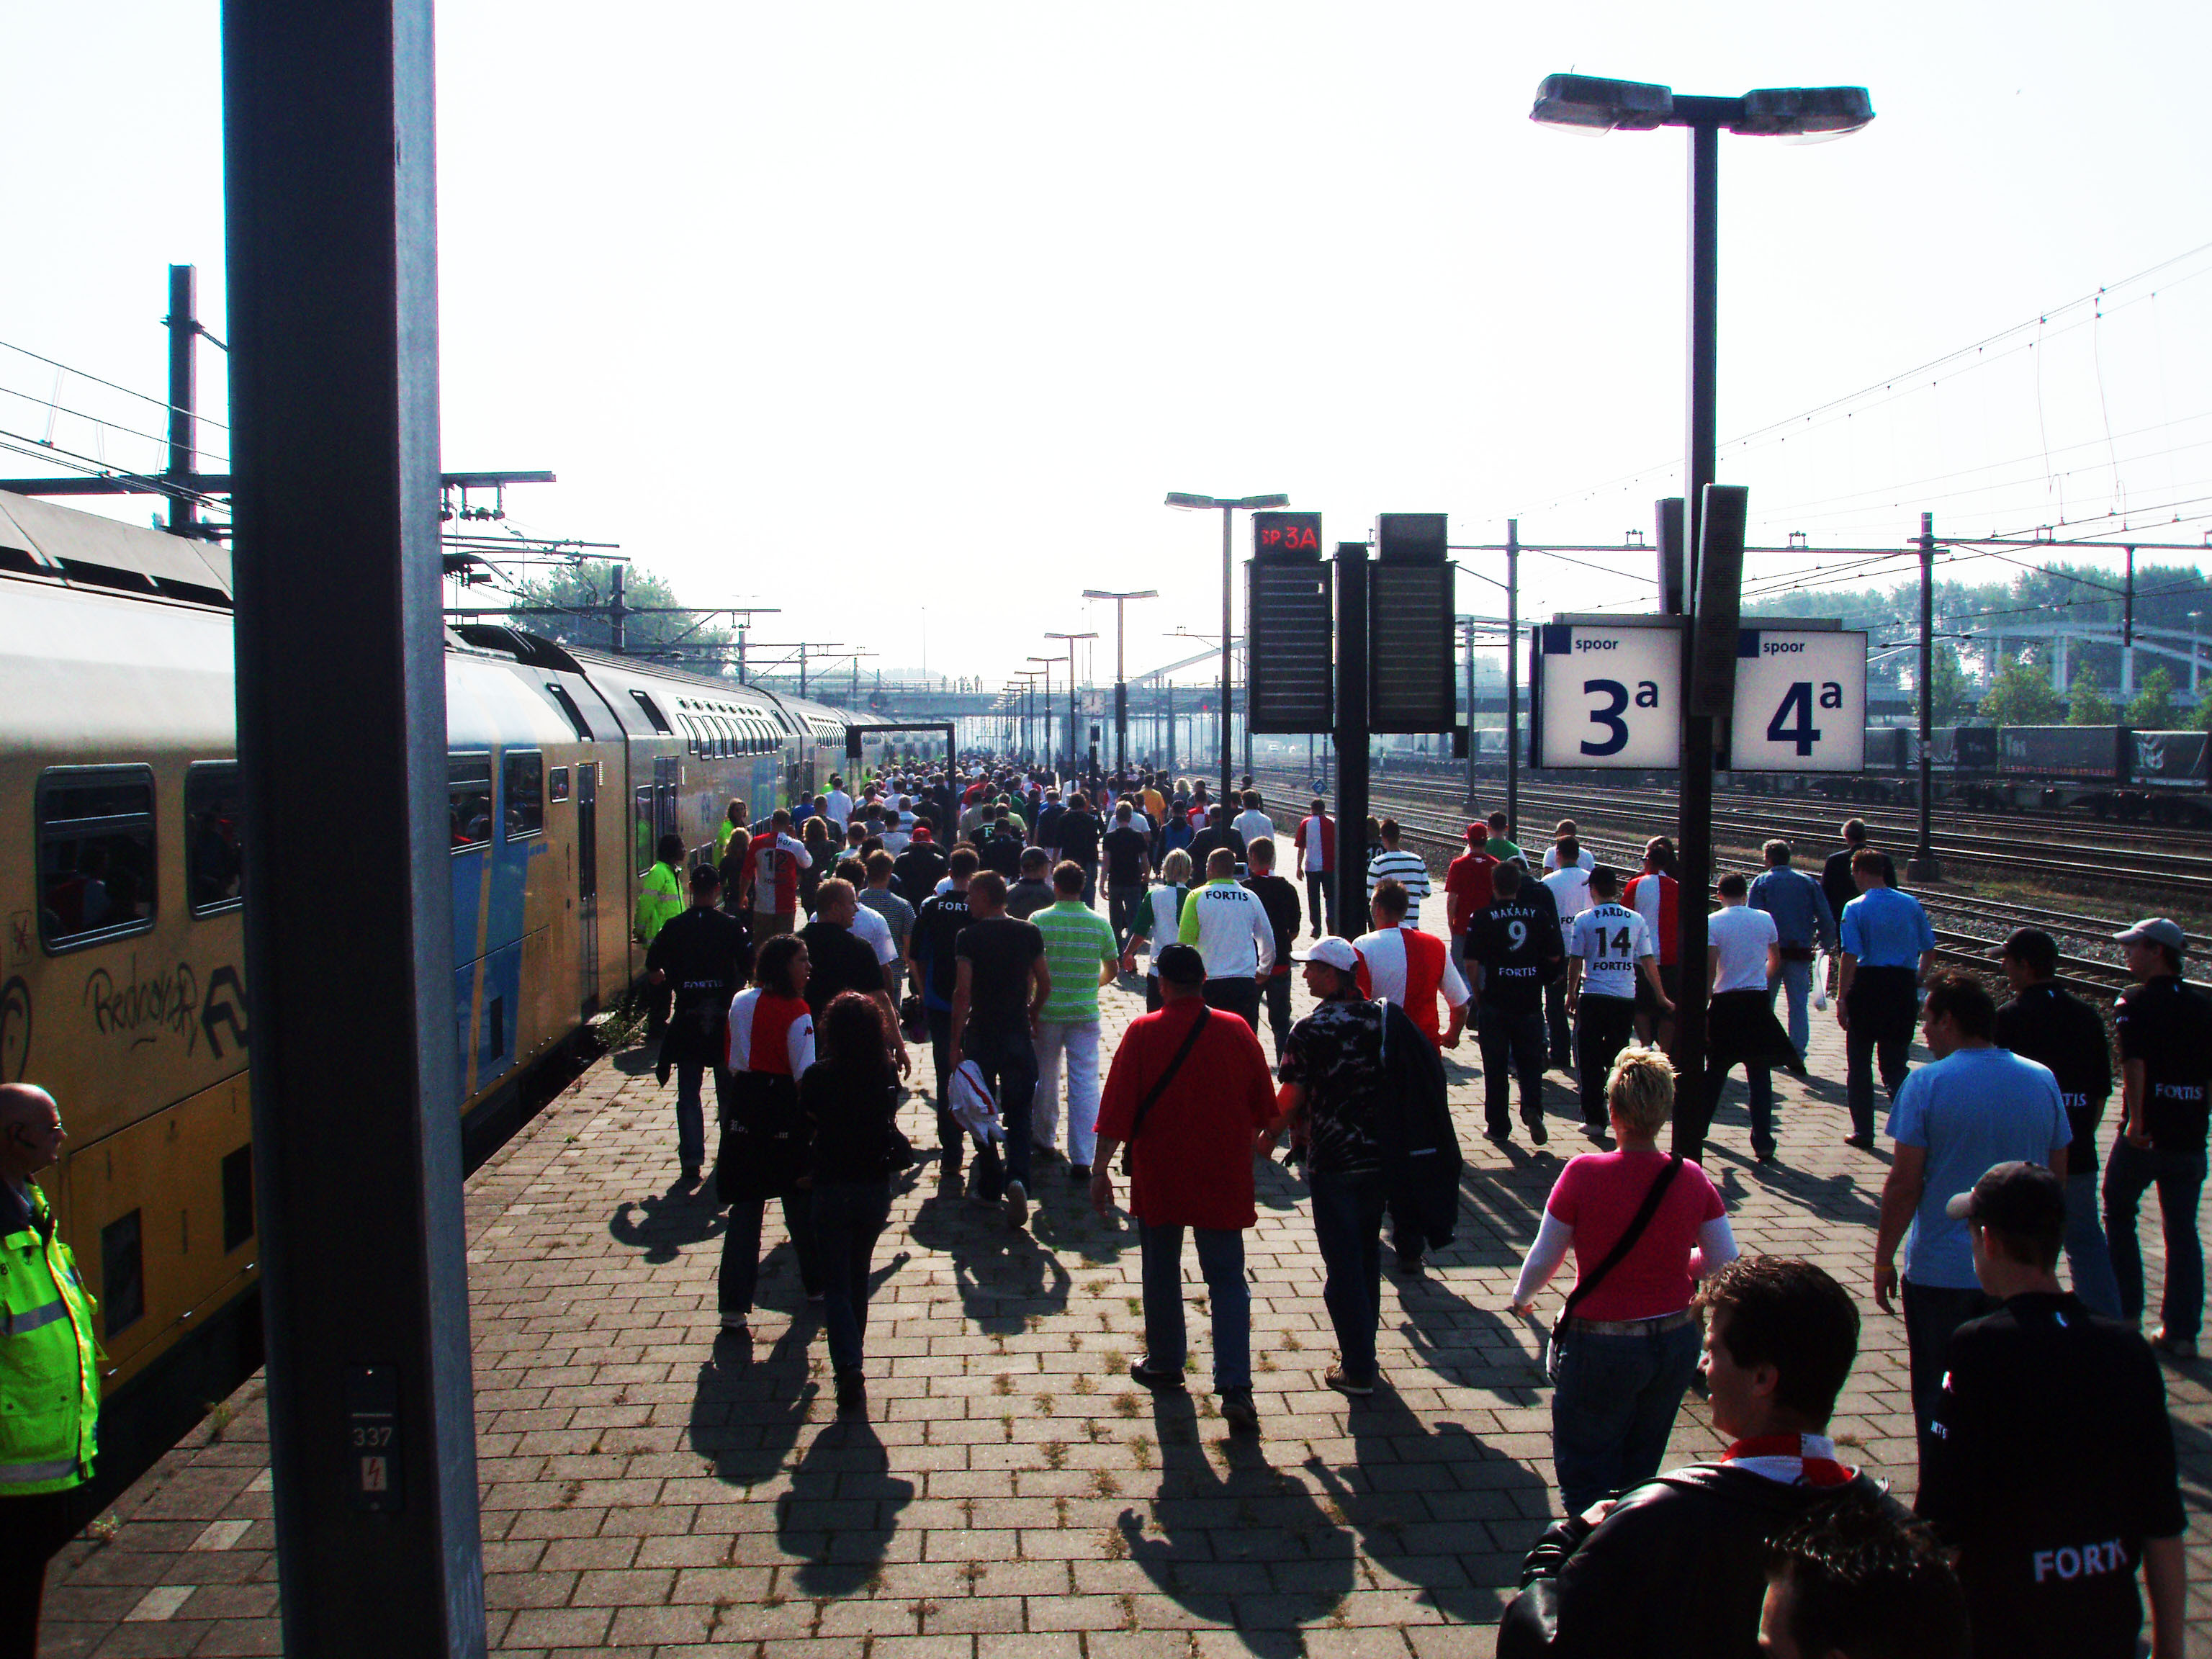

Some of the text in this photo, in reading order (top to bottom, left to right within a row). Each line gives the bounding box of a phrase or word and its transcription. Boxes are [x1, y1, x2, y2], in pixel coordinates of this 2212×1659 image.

[1284, 526, 1318, 549] 3A
[1575, 639, 1619, 653] spoor
[1763, 640, 1805, 656] spoor
[1205, 890, 1249, 902] FORTIS
[1490, 907, 1536, 921] MAKAAY
[1593, 906, 1631, 919] PARDO
[1560, 915, 1575, 925] FO
[1508, 920, 1527, 951] 9
[1594, 926, 1632, 958] 14
[1498, 966, 1538, 978] FORTIS
[1593, 961, 1632, 971] FORTIS
[2062, 1092, 2087, 1107] TIS
[352, 1426, 392, 1447] 337
